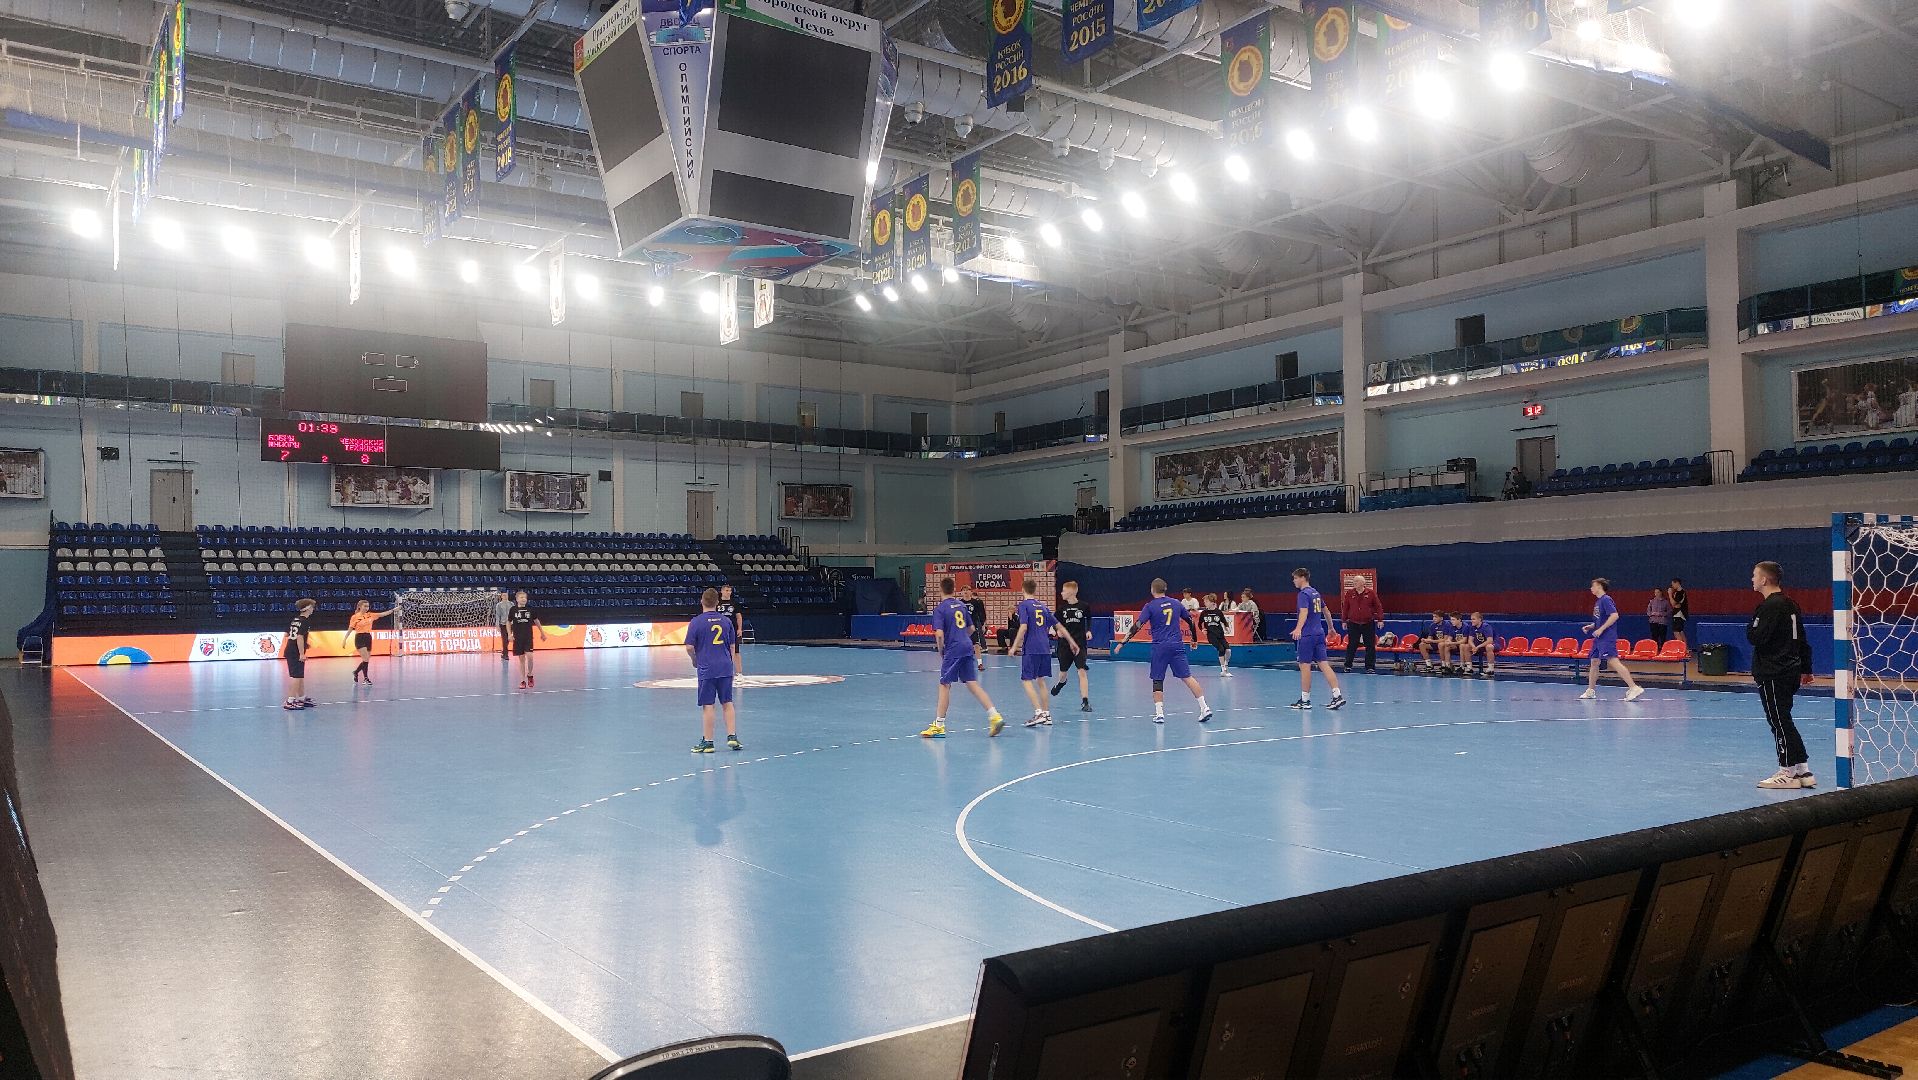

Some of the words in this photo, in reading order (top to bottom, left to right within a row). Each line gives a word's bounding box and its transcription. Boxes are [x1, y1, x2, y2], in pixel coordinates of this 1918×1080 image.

[794, 16, 835, 37] Чехов
[831, 13, 869, 32] округ
[1069, 16, 1106, 52] 2015
[662, 45, 702, 56] СПОРТА
[993, 60, 1028, 95] 2016
[679, 62, 695, 179] ОЛИМПИЙСКИЙ
[907, 251, 927, 272] 2020
[873, 266, 894, 284] 2020
[281, 450, 290, 461] 7
[361, 454, 369, 464] 8
[954, 610, 966, 629] 8
[1035, 609, 1044, 627] 5
[1063, 610, 1068, 618] 2
[1163, 608, 1173, 626] 7
[439, 629, 466, 637] ТУРНИР
[711, 624, 724, 645] 2
[1791, 613, 1798, 640] 1
[403, 640, 437, 651] ГЕРОИ
[440, 639, 481, 650] ГОРОДА
